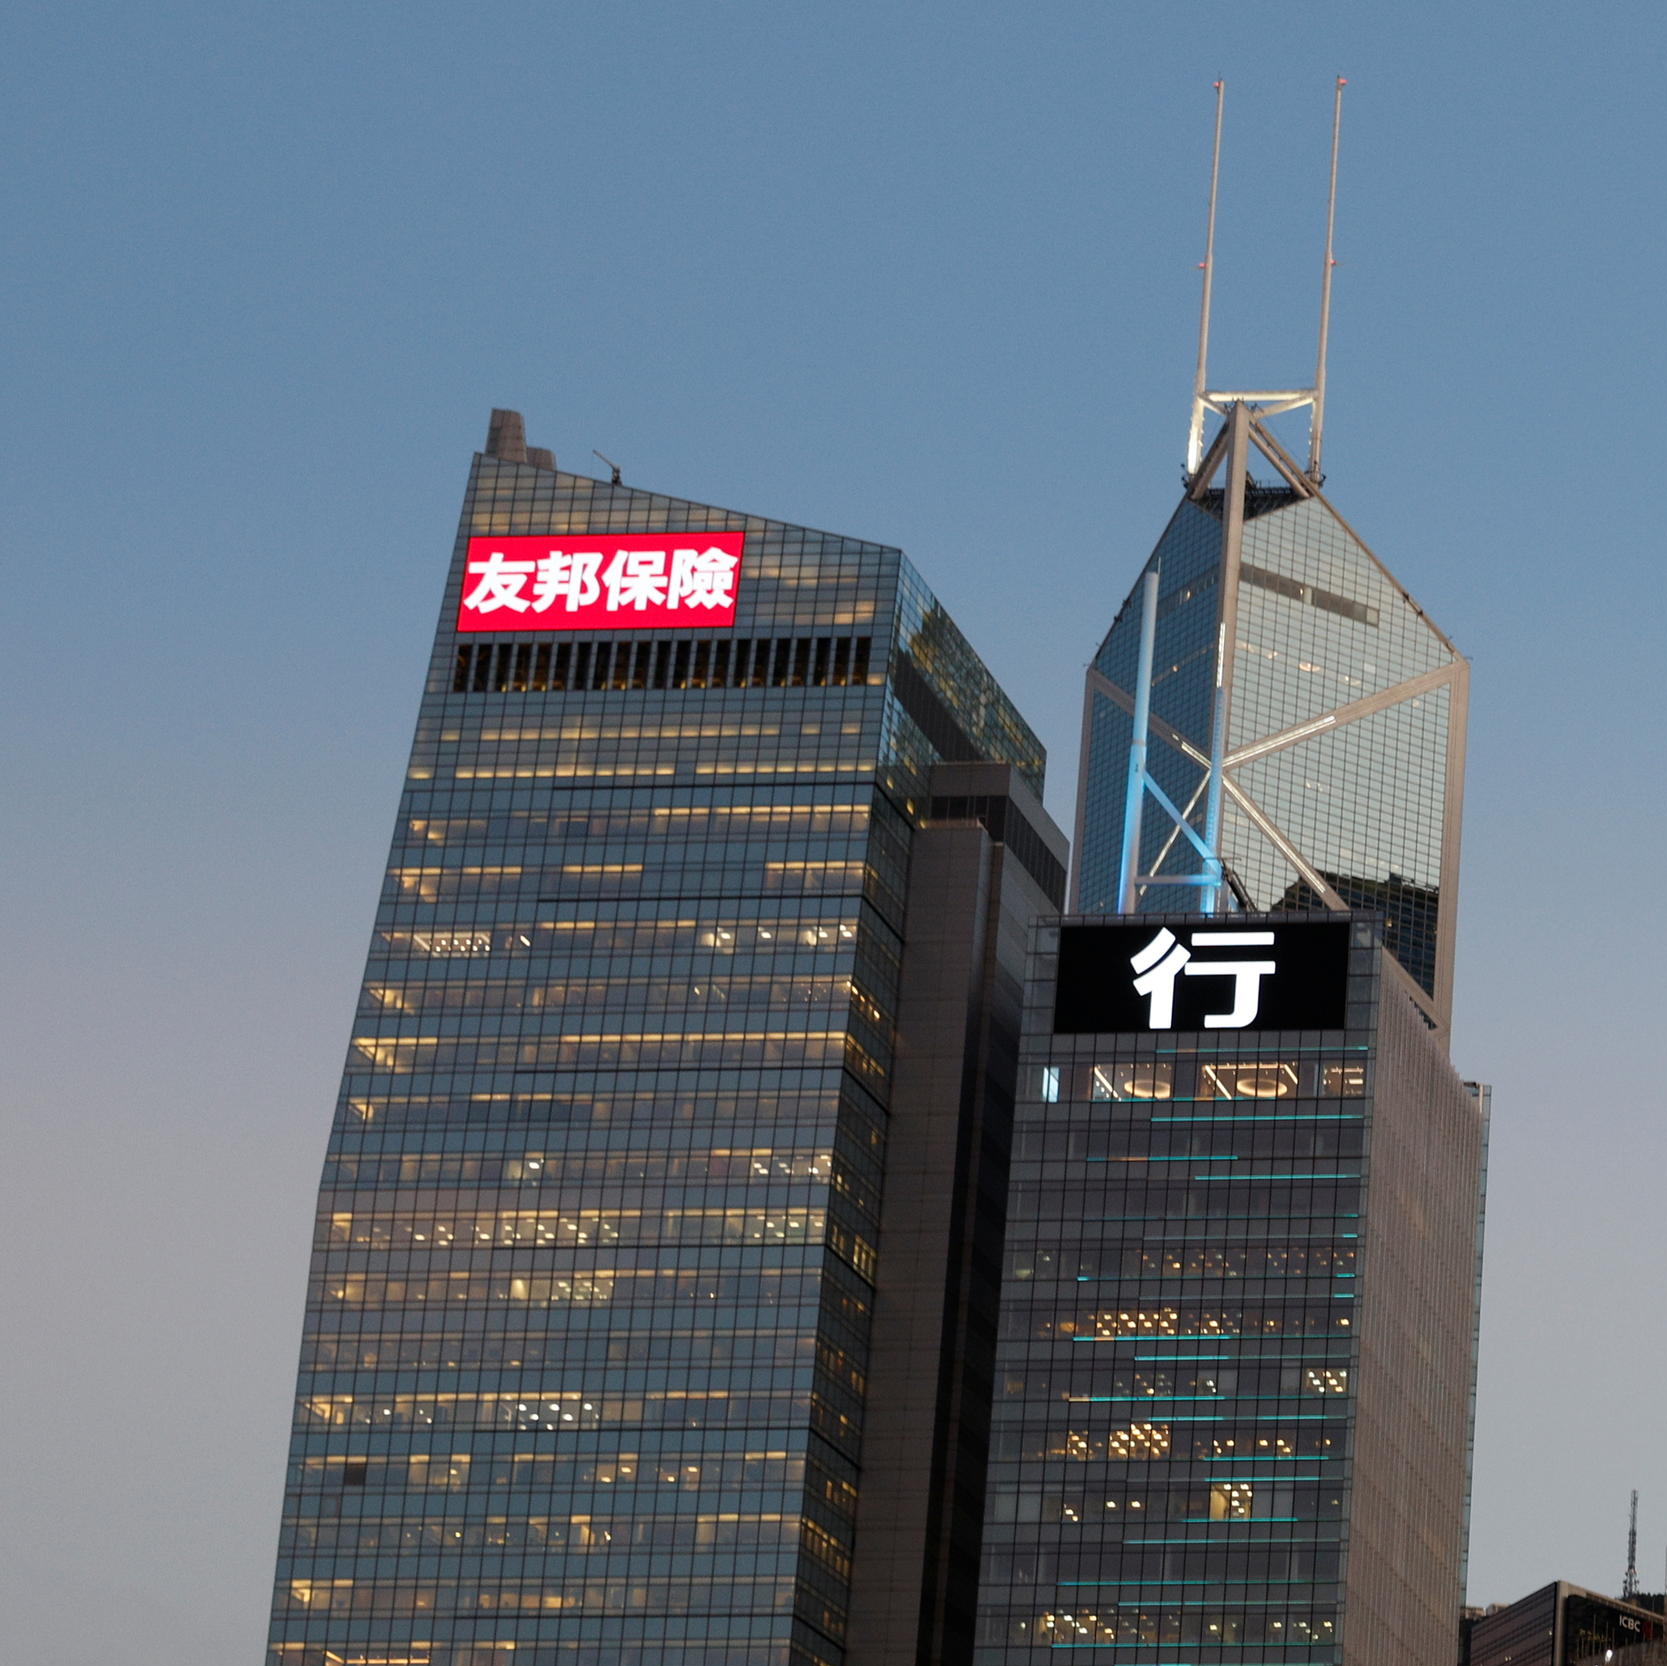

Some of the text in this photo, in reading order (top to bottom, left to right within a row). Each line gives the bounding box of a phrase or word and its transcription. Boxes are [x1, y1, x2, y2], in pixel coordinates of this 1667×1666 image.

[463, 545, 738, 614] 友邦保險
[1130, 927, 1276, 1029] 行
